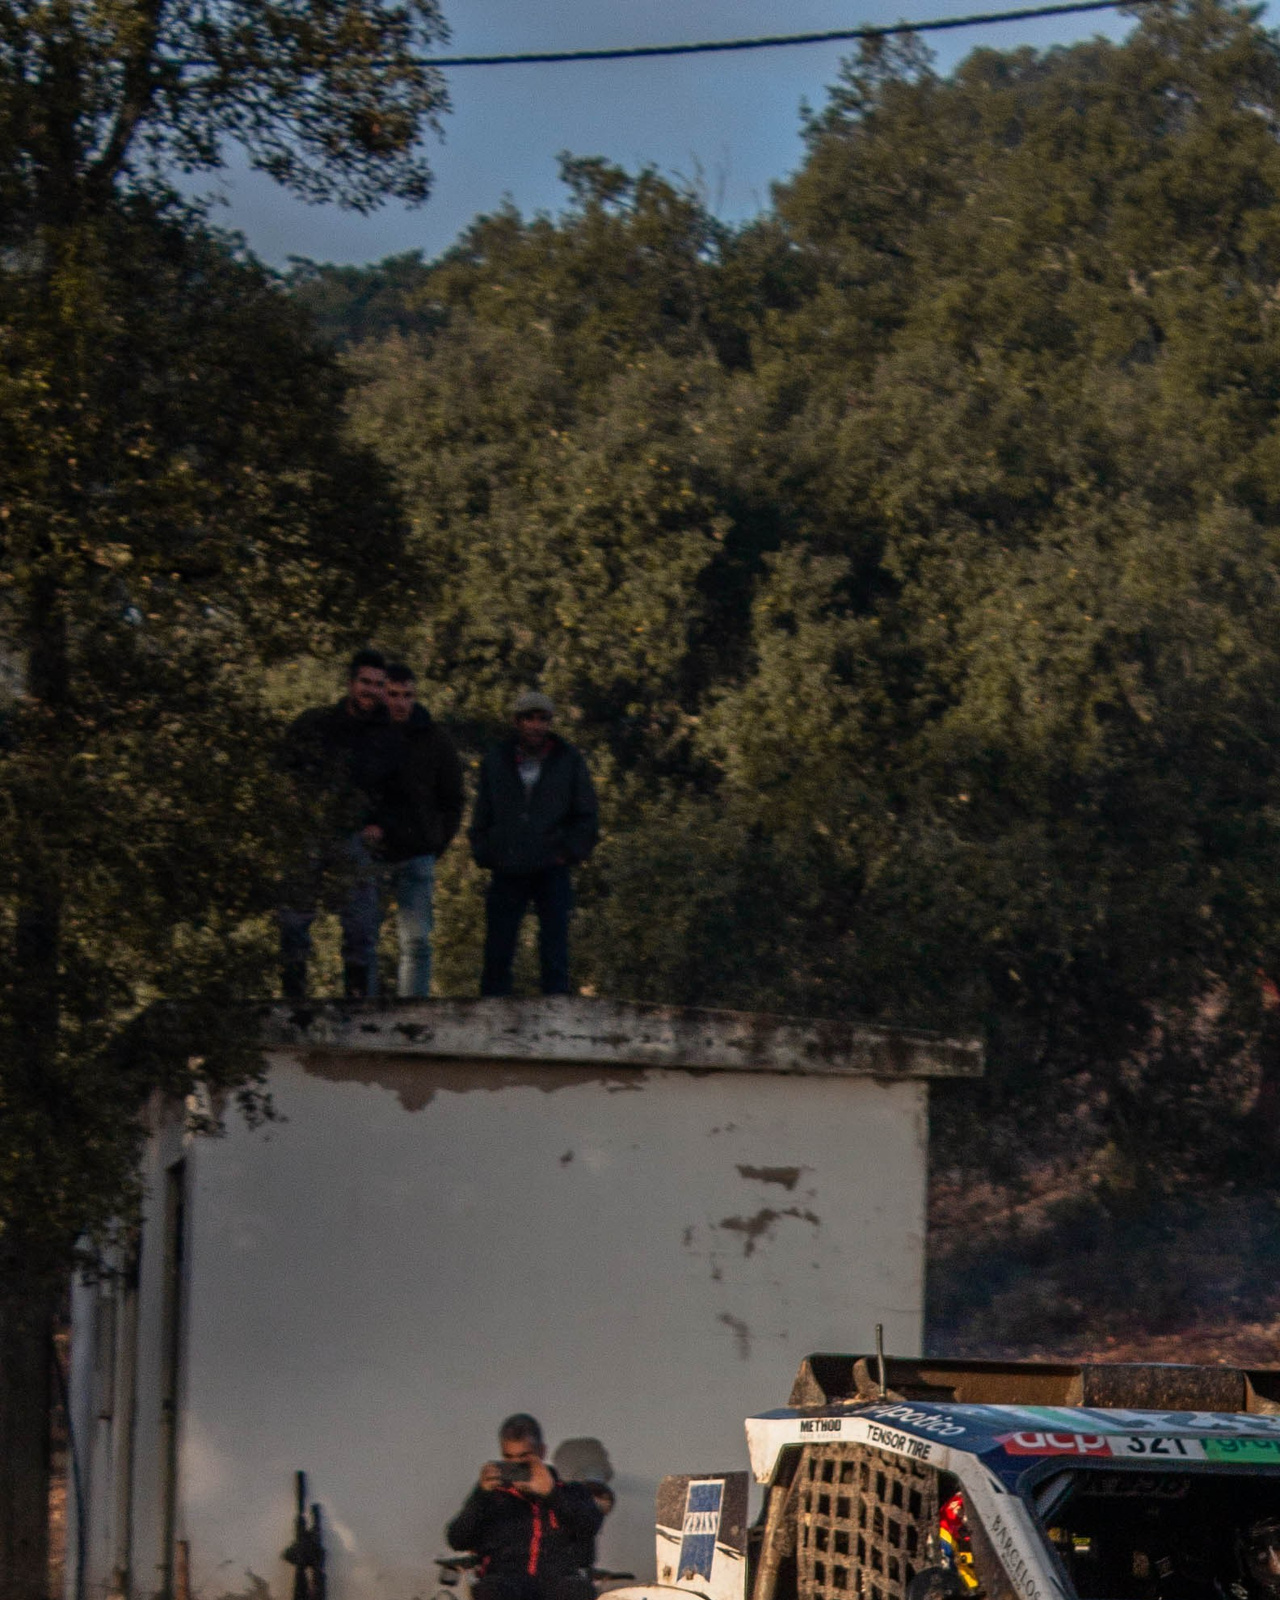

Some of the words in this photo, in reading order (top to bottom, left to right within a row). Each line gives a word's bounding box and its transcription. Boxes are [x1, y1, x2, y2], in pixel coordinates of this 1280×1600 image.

[799, 1420, 841, 1432] METHOD
[867, 1425, 906, 1451] TENSOR
[906, 1438, 932, 1460] TIRE
[1012, 1432, 1106, 1453] acp
[1127, 1437, 1188, 1454] 321
